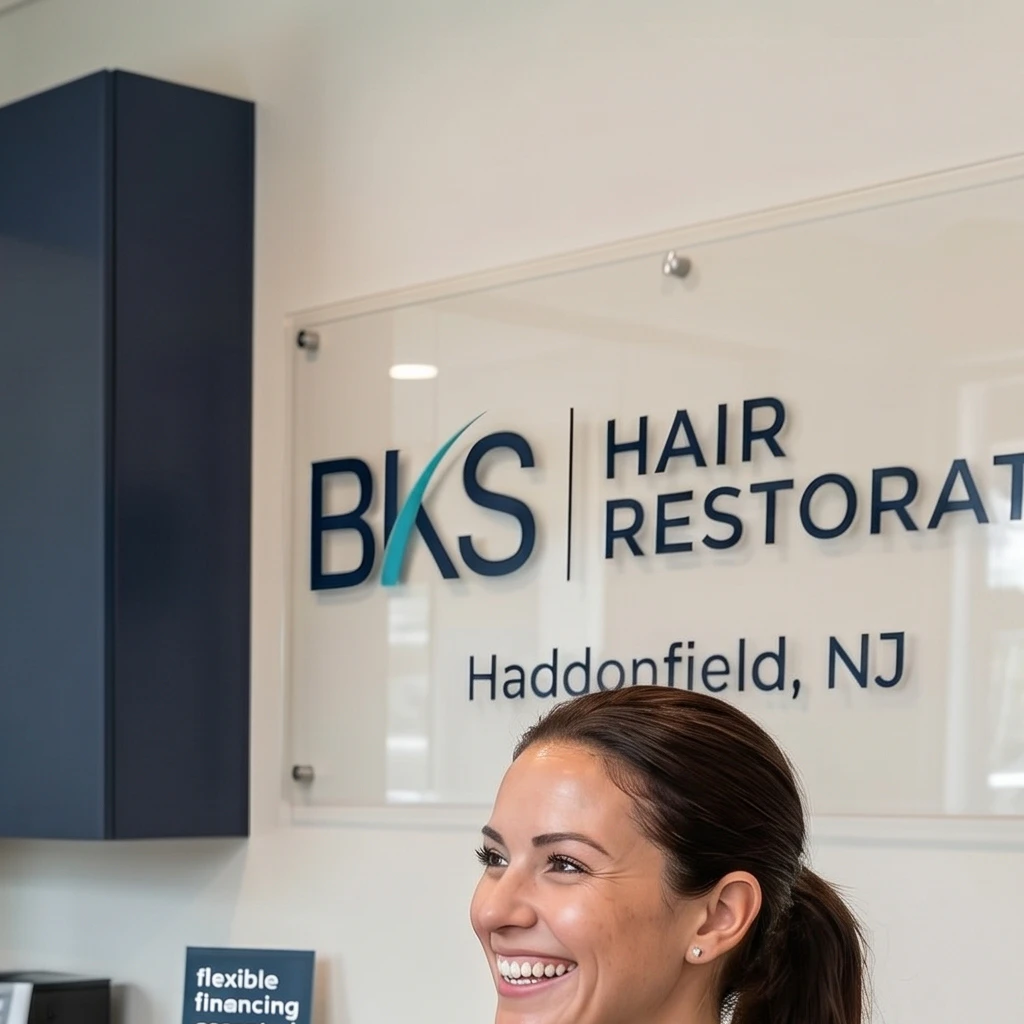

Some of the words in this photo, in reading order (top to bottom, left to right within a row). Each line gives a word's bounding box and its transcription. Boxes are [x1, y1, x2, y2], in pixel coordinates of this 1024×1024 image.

[605, 396, 787, 480] HAIR
[309, 411, 537, 591] BKS
[603, 452, 1024, 560] RESTORAT
[468, 636, 801, 701] Haddonfield,
[827, 631, 906, 690] NJ
[194, 991, 300, 1021] financing
[195, 967, 280, 990] flexible
